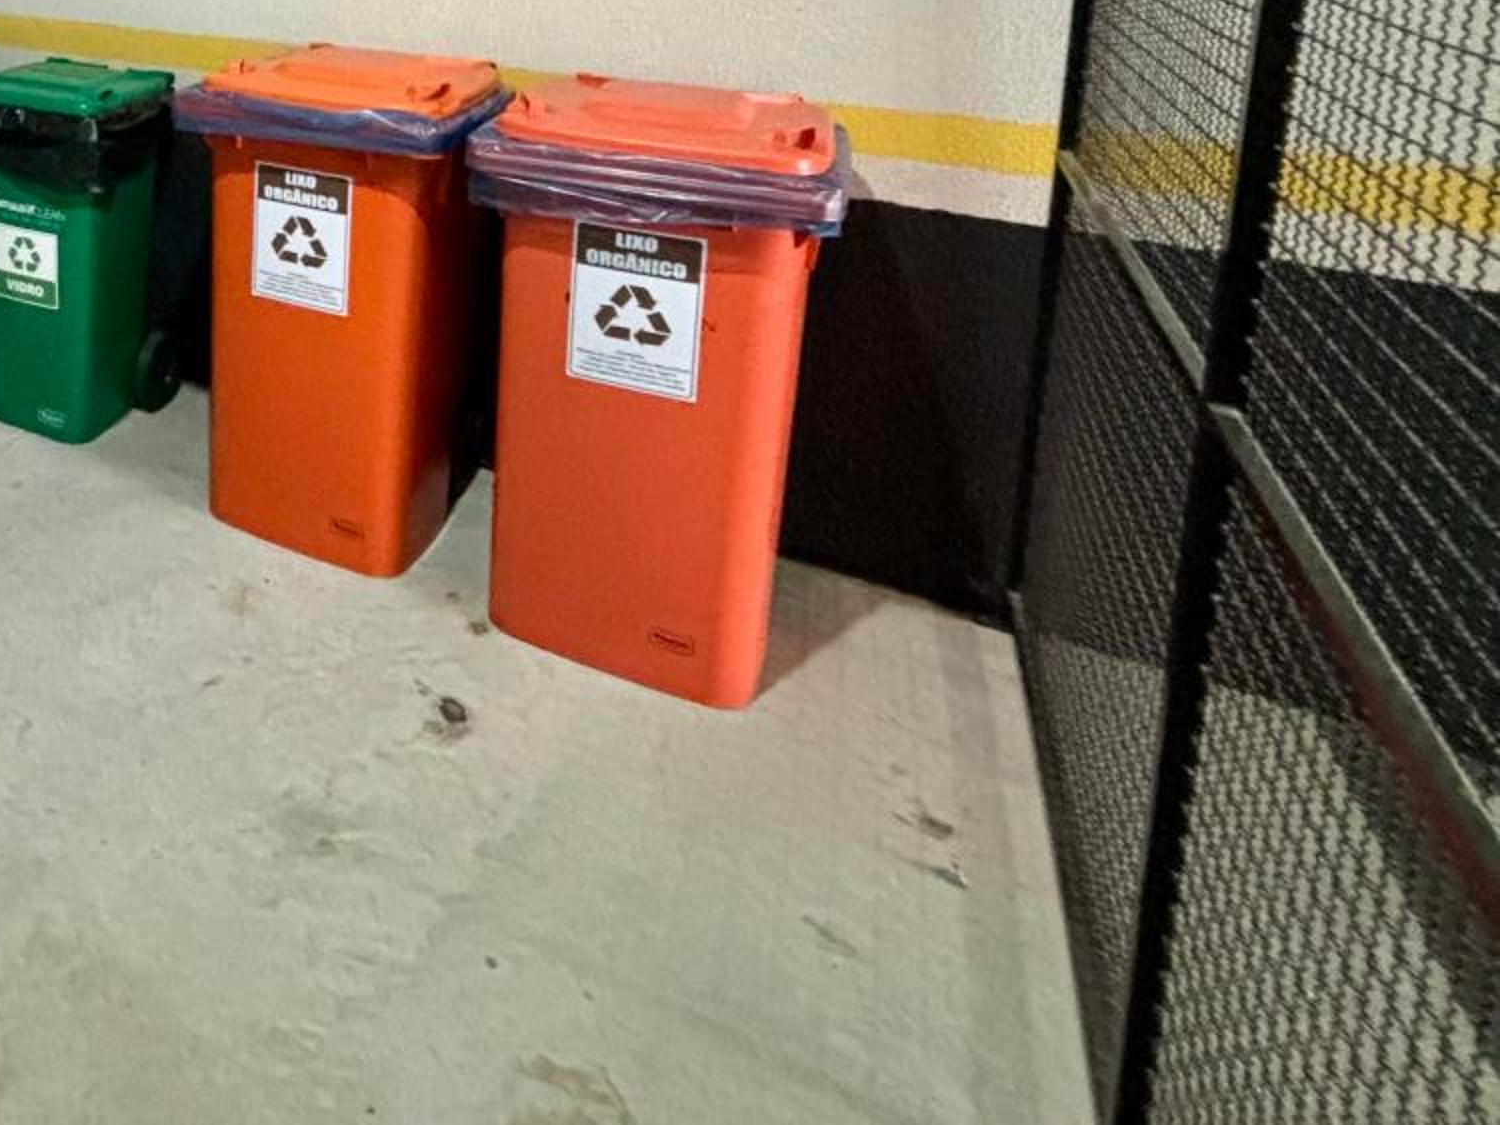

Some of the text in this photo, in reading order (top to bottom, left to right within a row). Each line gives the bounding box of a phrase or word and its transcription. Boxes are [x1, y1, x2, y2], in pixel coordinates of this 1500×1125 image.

[285, 171, 318, 189] LIXO
[615, 232, 659, 254] LIXO
[585, 248, 688, 280] ORGÂNICO
[6, 278, 45, 298] VIDRO
